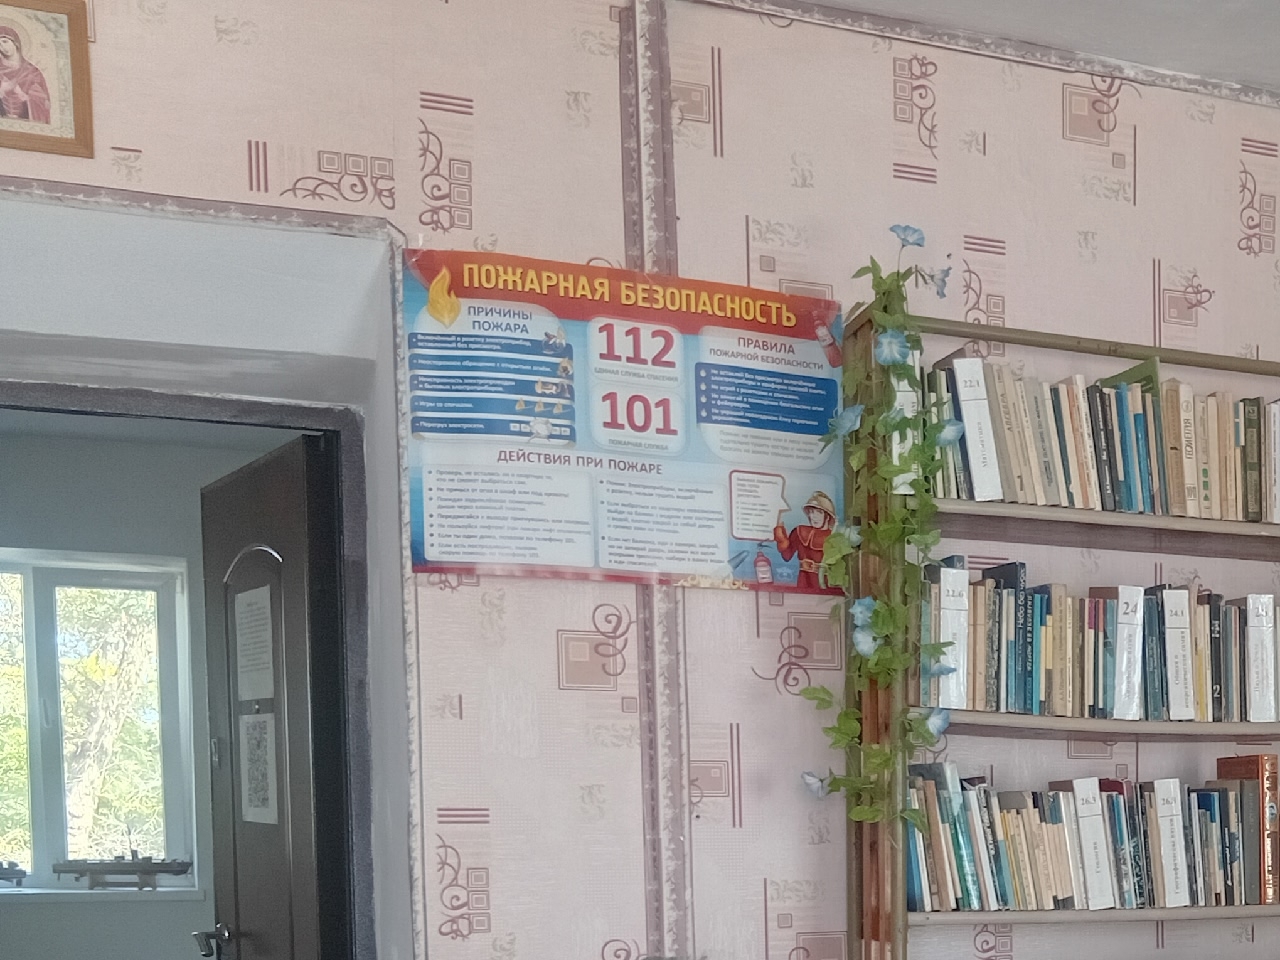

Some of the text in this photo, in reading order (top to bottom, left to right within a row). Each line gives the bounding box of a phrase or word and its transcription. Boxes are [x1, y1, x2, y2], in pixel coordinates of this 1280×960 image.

[463, 263, 797, 327] ПОЖАРНАЯ БЕЗОПАСНОСТЬ
[468, 306, 532, 320] ПРИЧИНЫ
[472, 321, 529, 333] ПОЖАРА
[598, 323, 676, 368] 112
[738, 337, 795, 355] ПРАВИЛА
[710, 349, 823, 370] ПОЖАРНОЙ БЕЗОПАСНОСТИ
[601, 392, 678, 435] 101
[1000, 393, 1013, 432] АЛГЕБРА
[1183, 418, 1193, 459] ГЕОМЕТРИЯ
[497, 449, 662, 474] ДЕЙСТВИЯ ПРИ ПОЖАРЕ
[1122, 602, 1137, 615] 24
[1169, 608, 1184, 617] 24.1
[1214, 685, 1220, 697] 2
